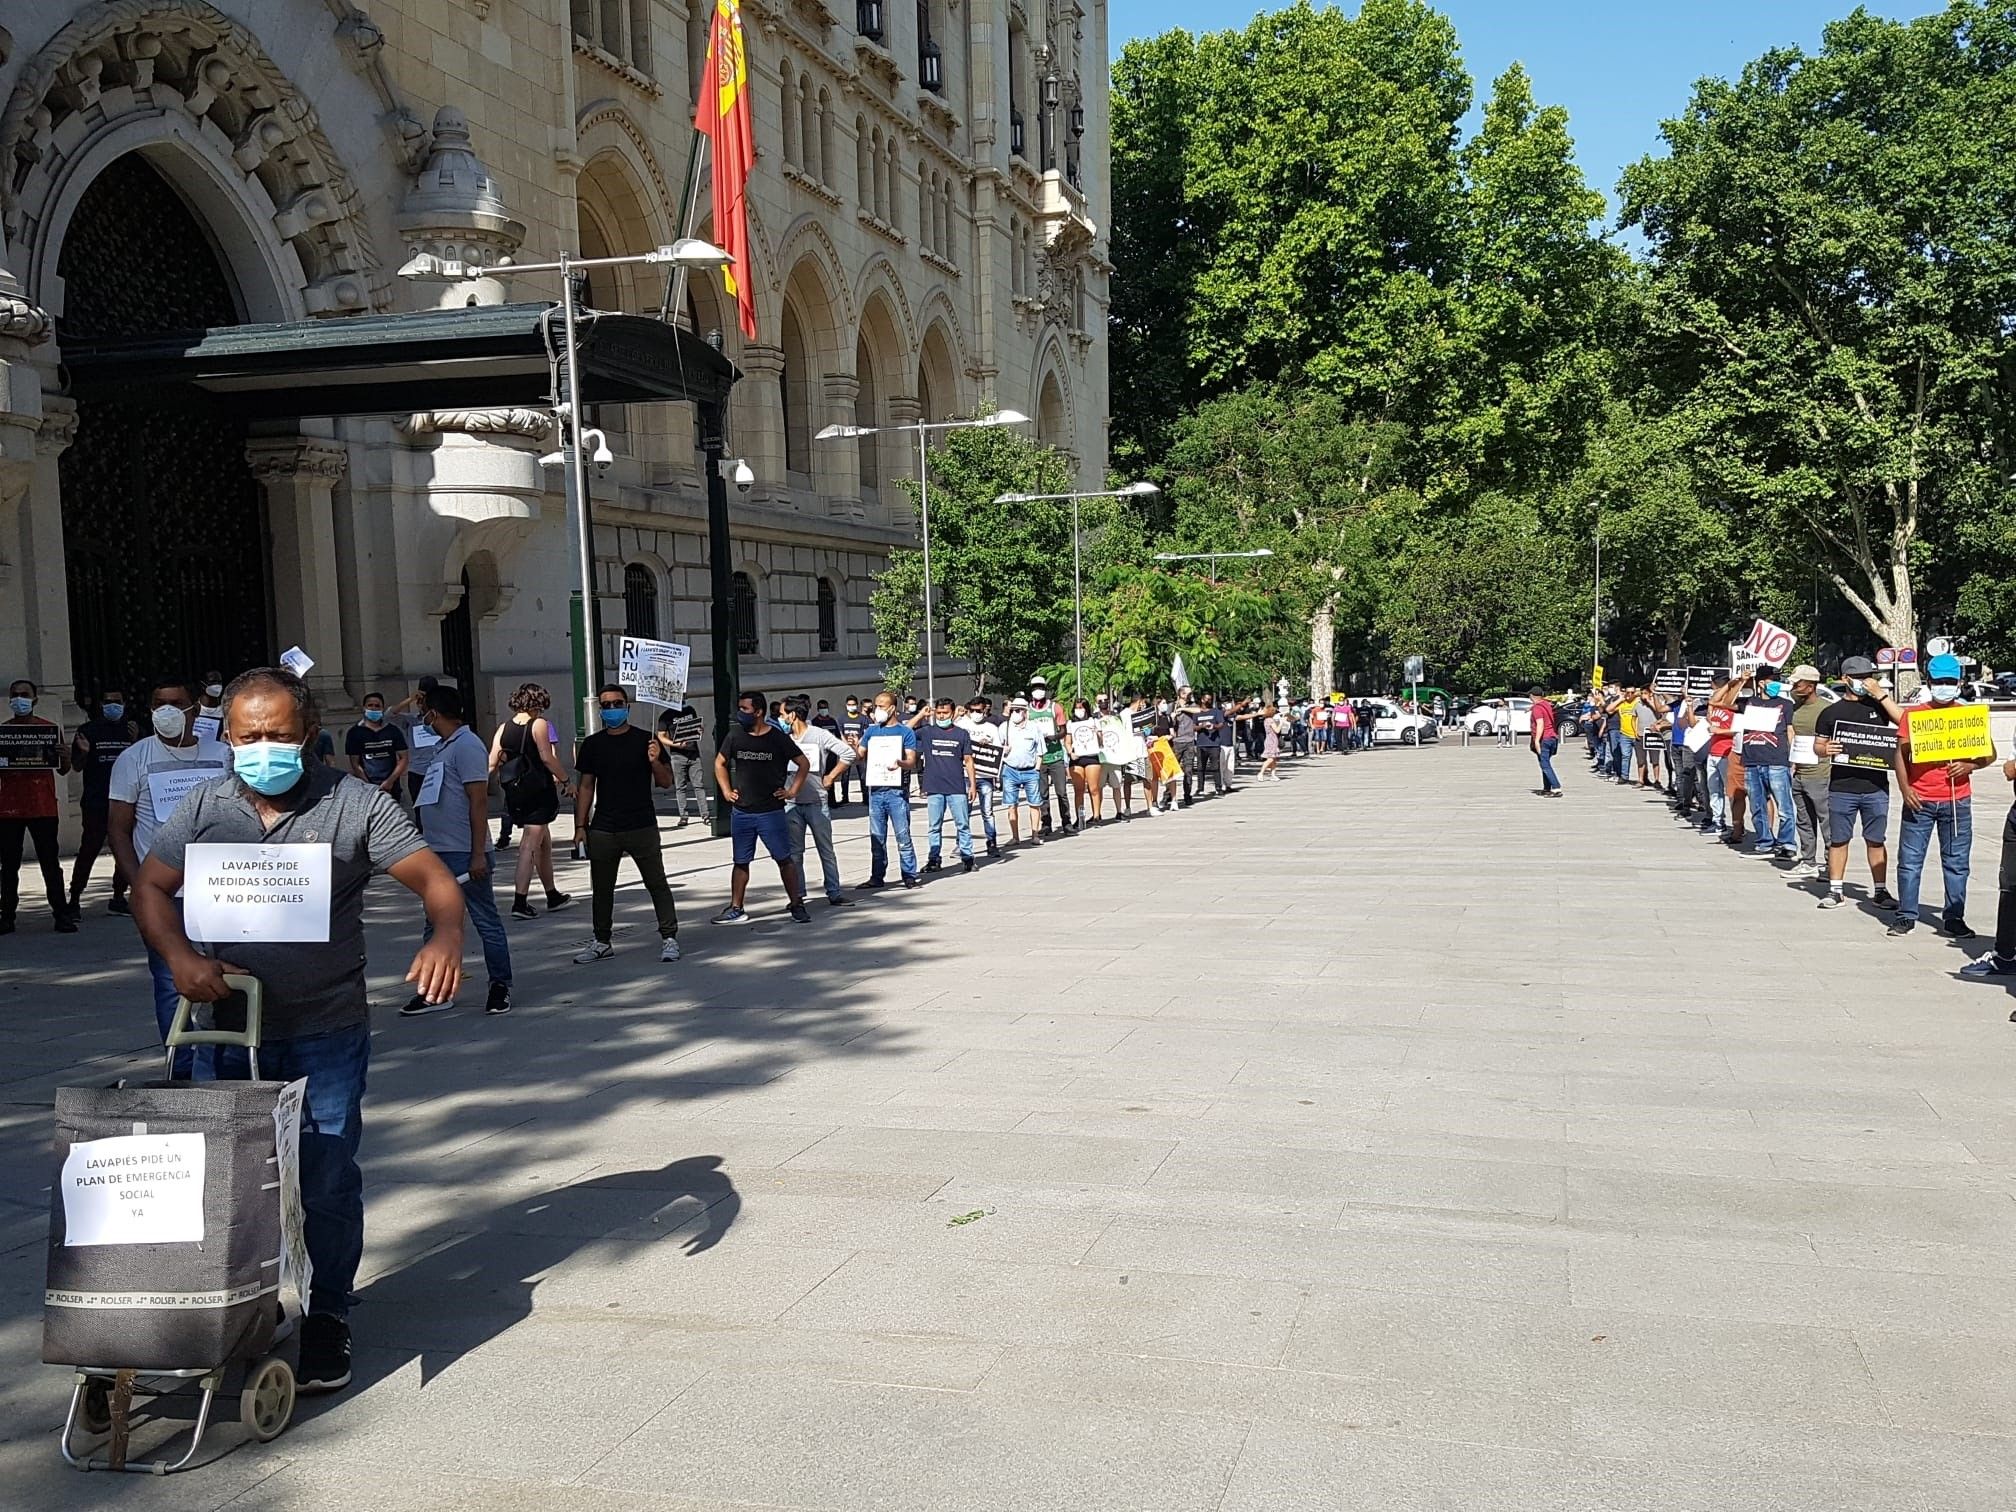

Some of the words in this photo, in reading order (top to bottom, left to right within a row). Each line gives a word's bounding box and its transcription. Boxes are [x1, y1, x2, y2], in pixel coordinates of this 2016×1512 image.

[1743, 622, 1791, 662] NO
[622, 640, 639, 659] R
[1948, 719, 1963, 731] para
[1946, 737, 1956, 749] de
[159, 795, 184, 803] PERSON
[222, 860, 273, 870] LAVAPIÉS
[277, 862, 298, 870] PIDE
[208, 877, 259, 886] MEDIDAS
[263, 877, 310, 886] SOCIALES
[214, 894, 220, 902] Y
[227, 894, 243, 903] NO
[247, 894, 304, 903] POLICIALES
[141, 1154, 164, 1164] PIDE
[167, 1153, 182, 1163] UN
[76, 1176, 105, 1187] PLAN
[109, 1174, 122, 1184] DE
[126, 1170, 191, 1183] EMERGENCIA
[119, 1189, 155, 1200] SOCIAL
[131, 1208, 144, 1217] YA
[56, 1294, 84, 1304] ROLSER
[100, 1296, 133, 1305] ROLSER
[149, 1296, 177, 1305] ROLSER
[191, 1295, 224, 1305] ROLSER
